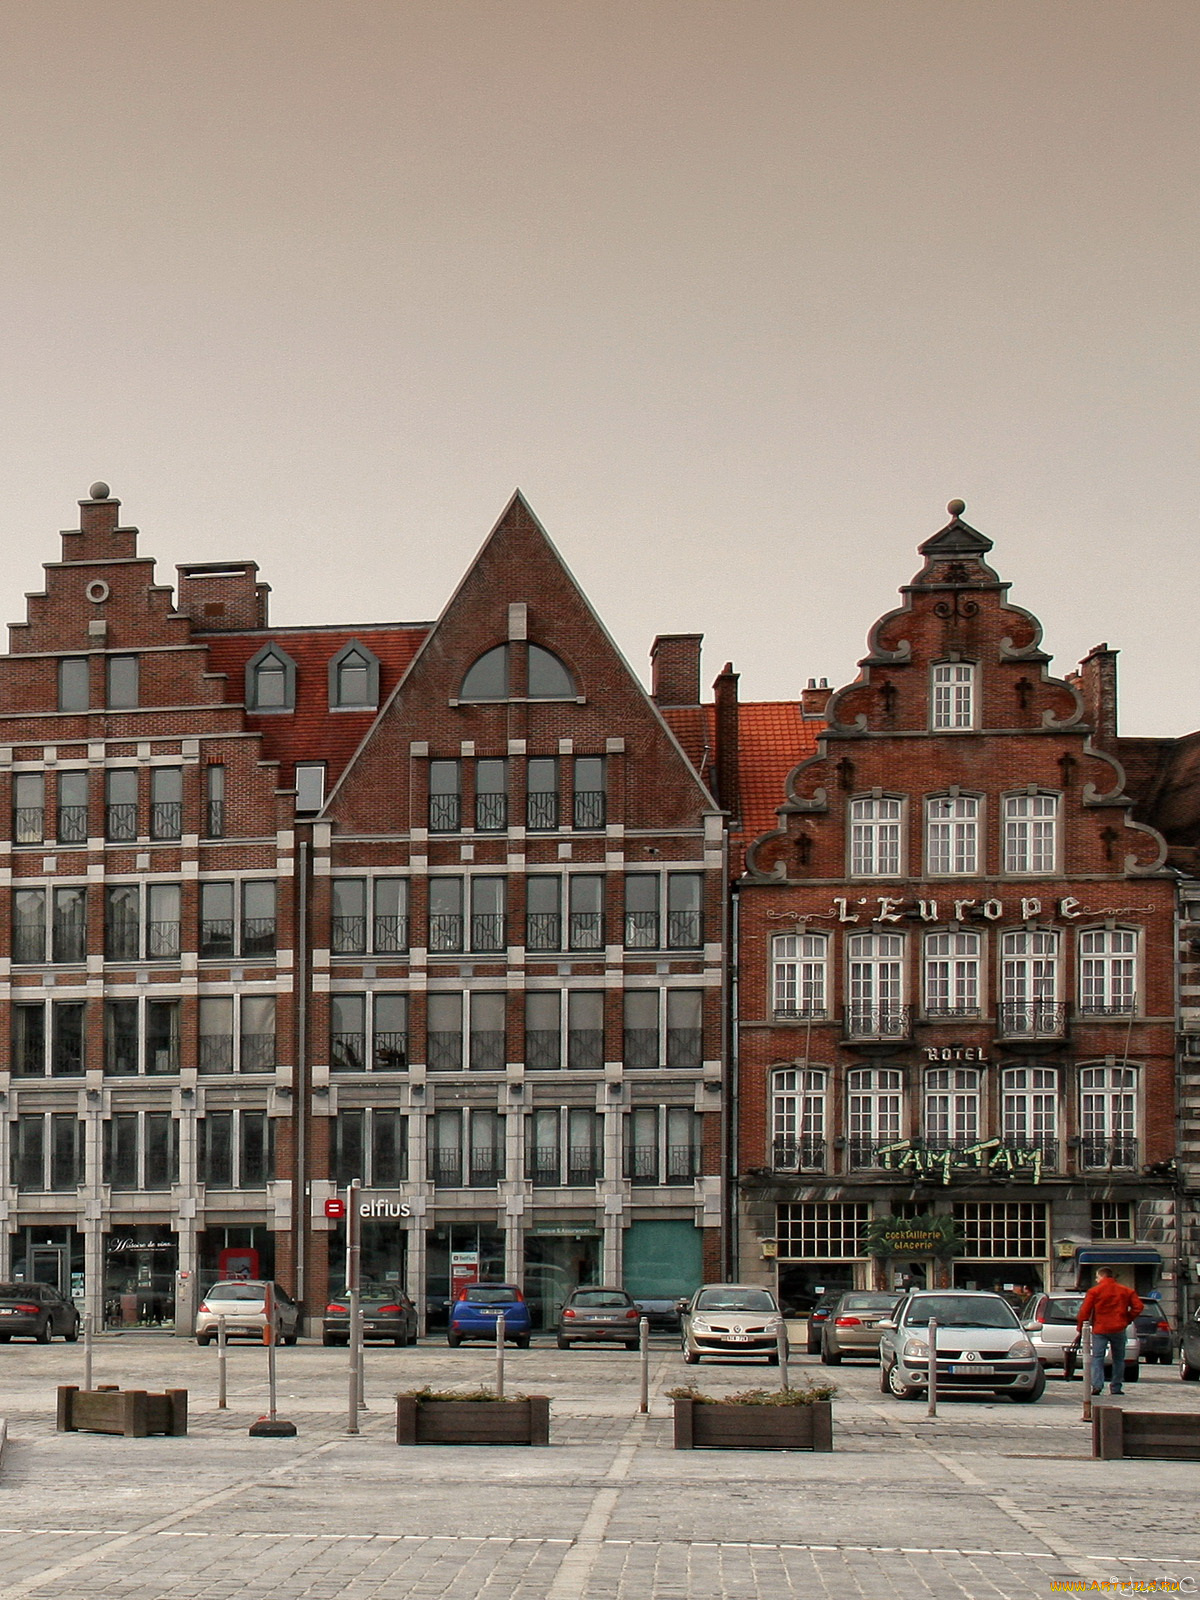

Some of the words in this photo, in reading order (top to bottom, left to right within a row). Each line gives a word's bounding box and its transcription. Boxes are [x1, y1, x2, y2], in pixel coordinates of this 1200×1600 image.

[834, 897, 1081, 922] L'Europe
[922, 1047, 988, 1060] HOTEL
[357, 1199, 411, 1218] elfius
